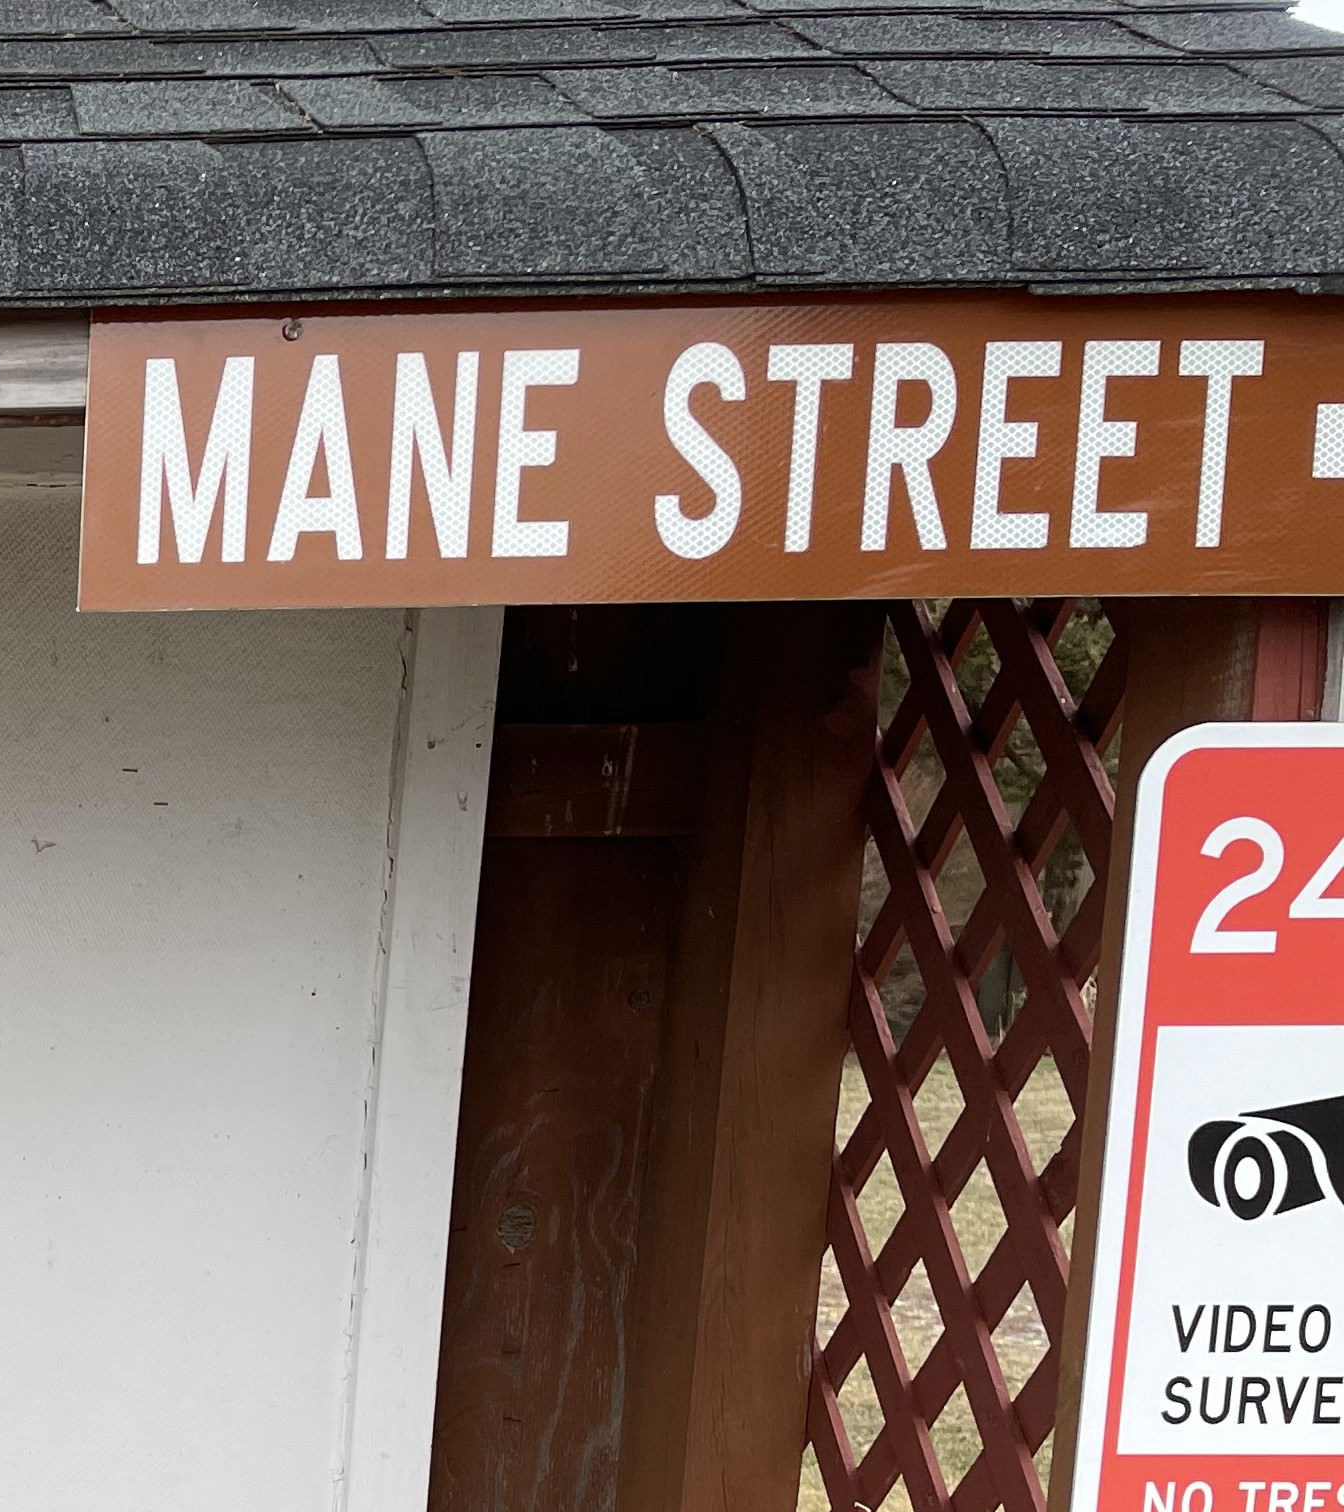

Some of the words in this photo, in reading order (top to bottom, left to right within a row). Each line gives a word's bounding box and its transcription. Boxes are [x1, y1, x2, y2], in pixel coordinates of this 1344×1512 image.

[136, 348, 581, 565] MANE
[653, 338, 1265, 560] STREET
[1171, 1304, 1332, 1353] VIDEO
[1161, 1376, 1344, 1424] SURVE
